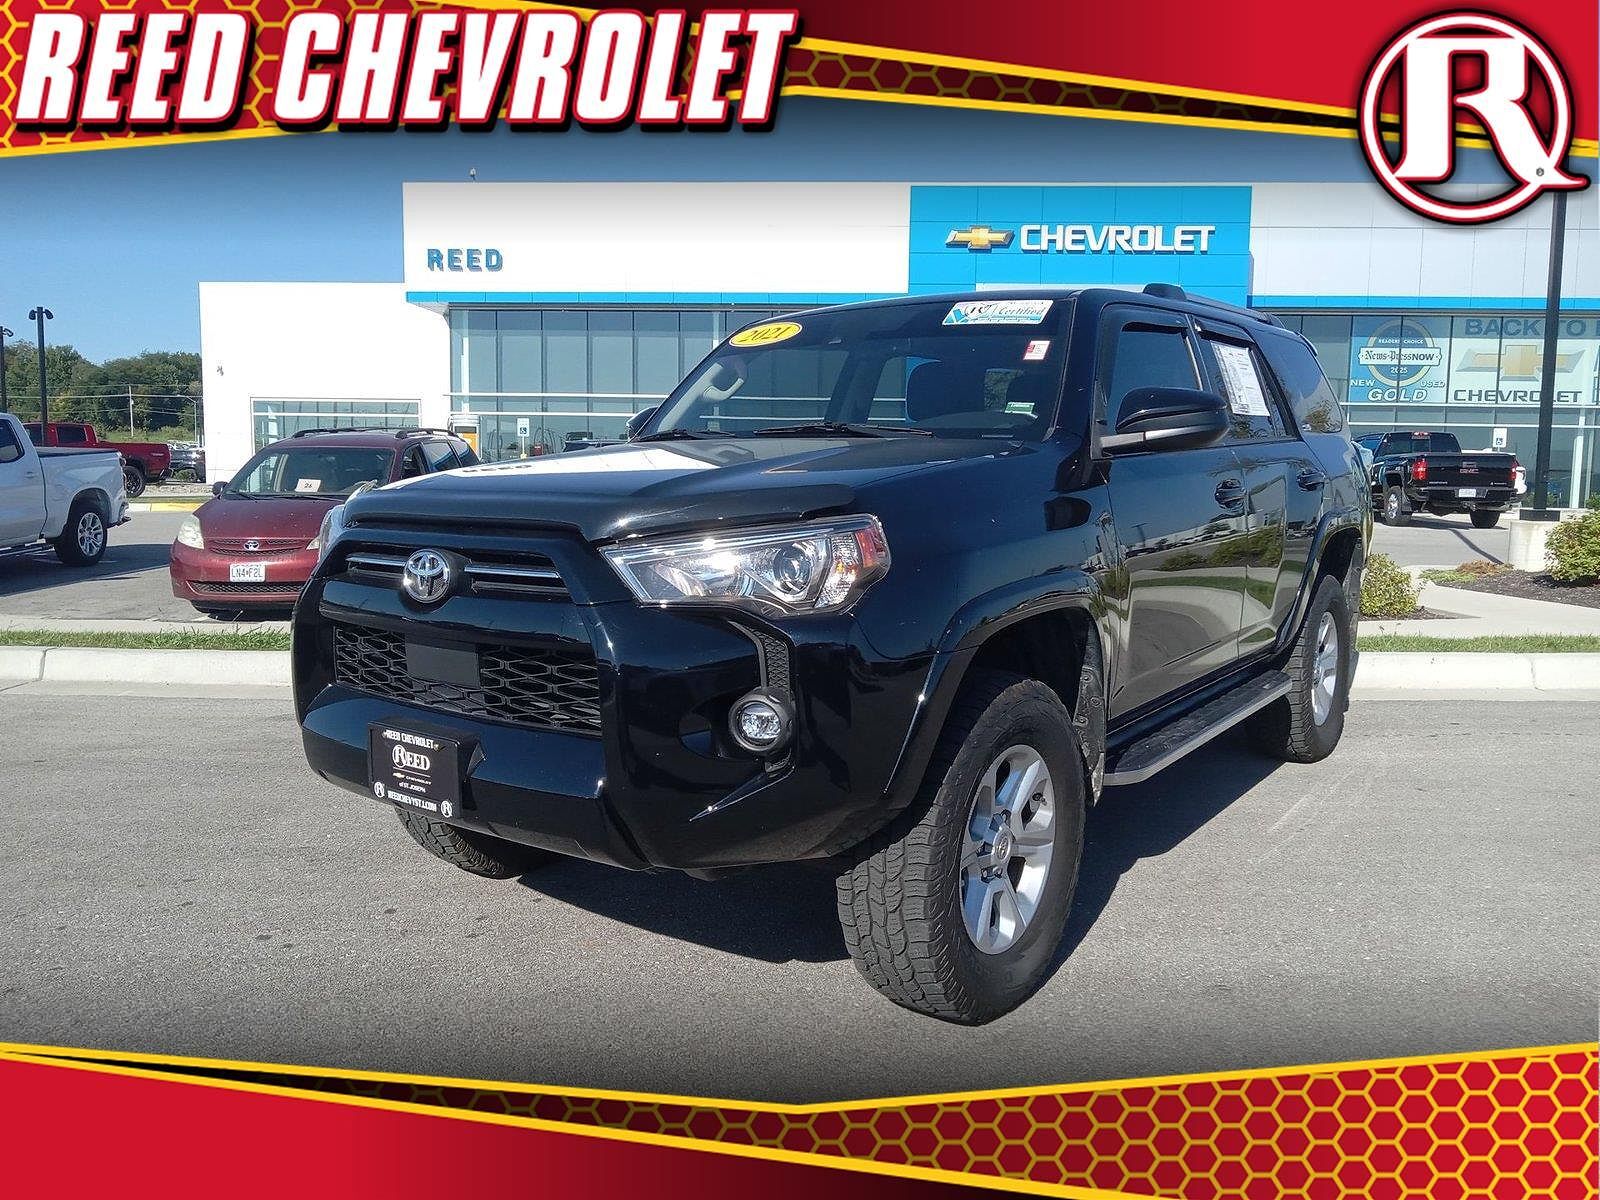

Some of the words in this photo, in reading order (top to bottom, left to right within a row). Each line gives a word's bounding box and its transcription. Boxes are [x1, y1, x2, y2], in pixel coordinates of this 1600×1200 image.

[1020, 224, 1216, 252] CHEVROLET
[427, 248, 503, 272] REED
[738, 325, 792, 343] 2021
[1465, 319, 1540, 336] BACK
[1350, 379, 1376, 387] NEW
[1420, 380, 1446, 388] USED
[1367, 388, 1428, 402] GOLD
[1453, 389, 1582, 403] CHEVROET
[385, 729, 401, 741] REED
[401, 733, 434, 749] CHEVROLET
[392, 744, 430, 770] REED
